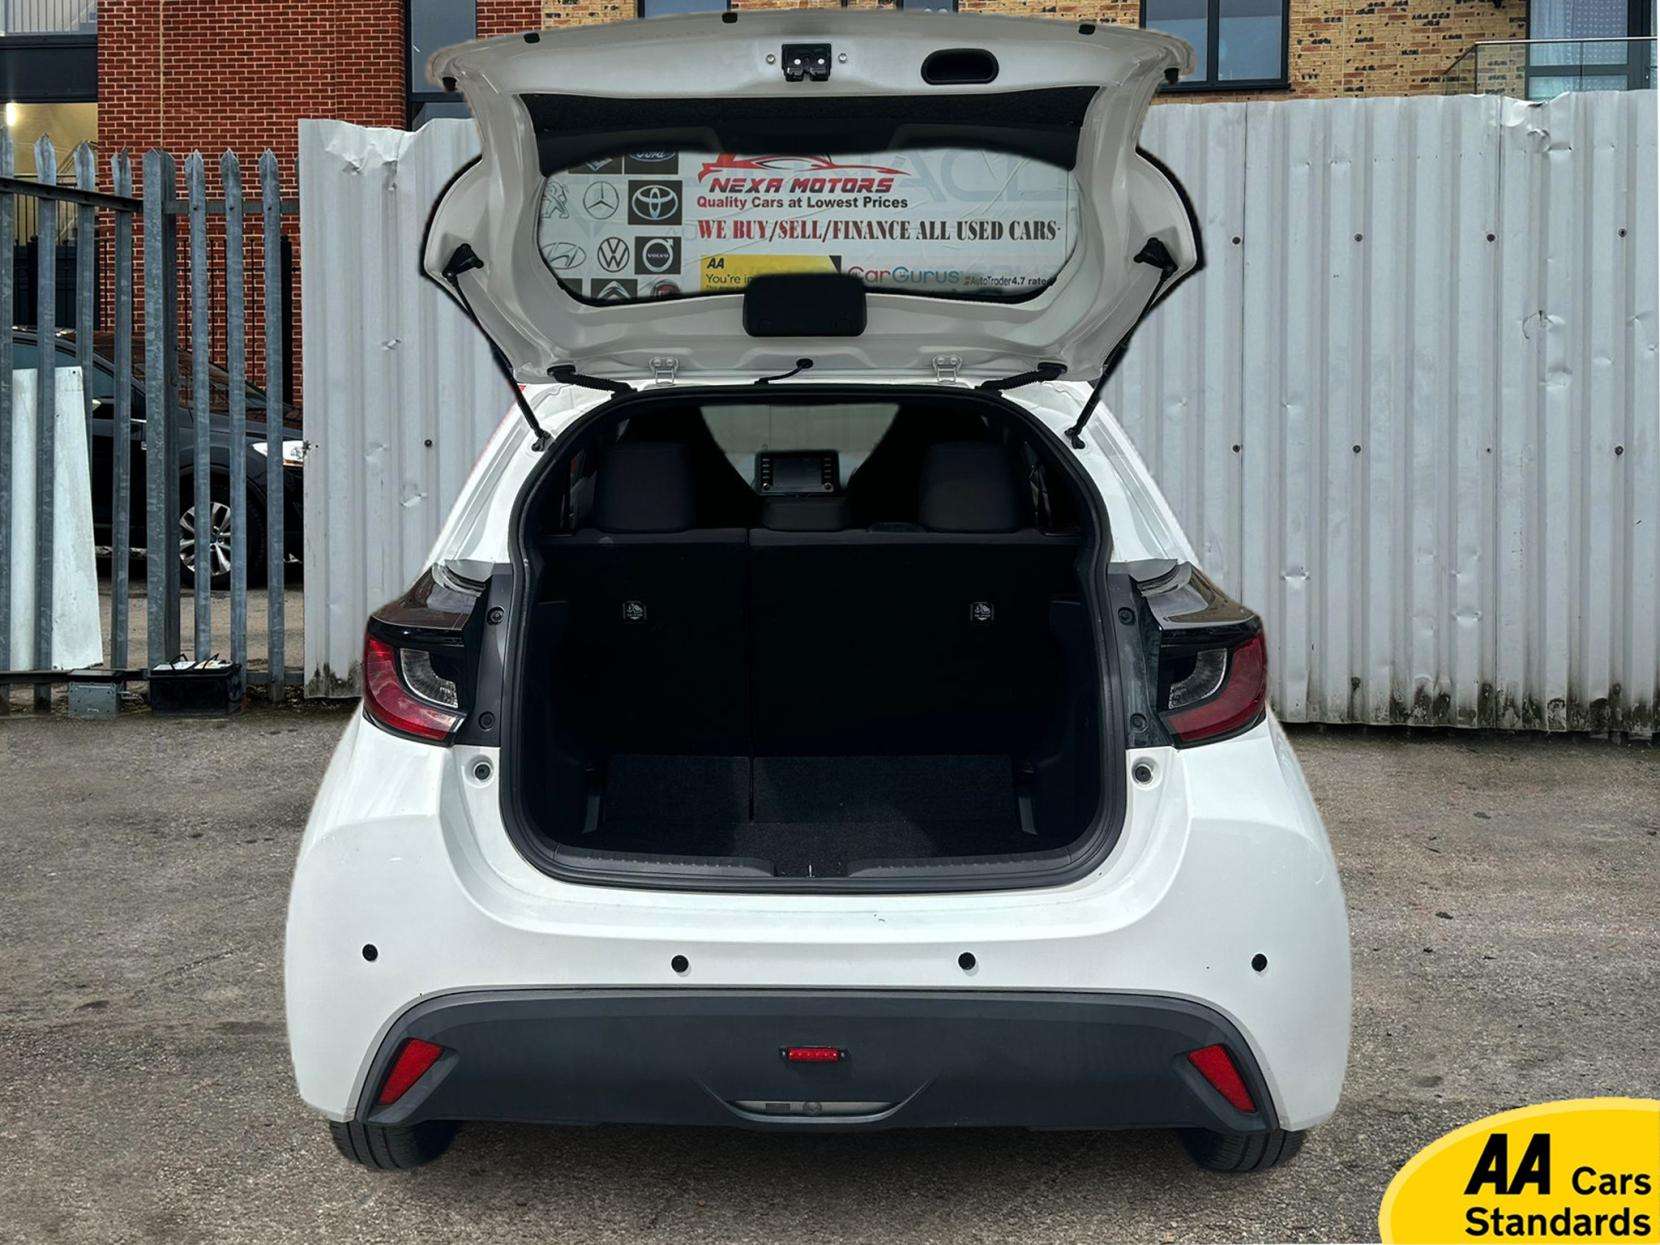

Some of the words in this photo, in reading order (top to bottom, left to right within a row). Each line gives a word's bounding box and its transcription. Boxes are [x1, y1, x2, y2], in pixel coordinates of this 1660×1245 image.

[709, 177, 783, 193] NEXA
[789, 178, 894, 193] MOTORS
[697, 196, 747, 211] Quality
[752, 196, 784, 208] Cars
[788, 197, 802, 208] at
[807, 196, 858, 208] Lowest
[863, 196, 908, 208] Prices
[698, 220, 726, 239] WE
[733, 219, 910, 243] BUY/SELL/FINANCE
[916, 220, 950, 240] ALL
[956, 220, 1004, 241] USED
[706, 258, 725, 269] AA
[705, 273, 741, 284] You're
[848, 266, 961, 284] CarGurus
